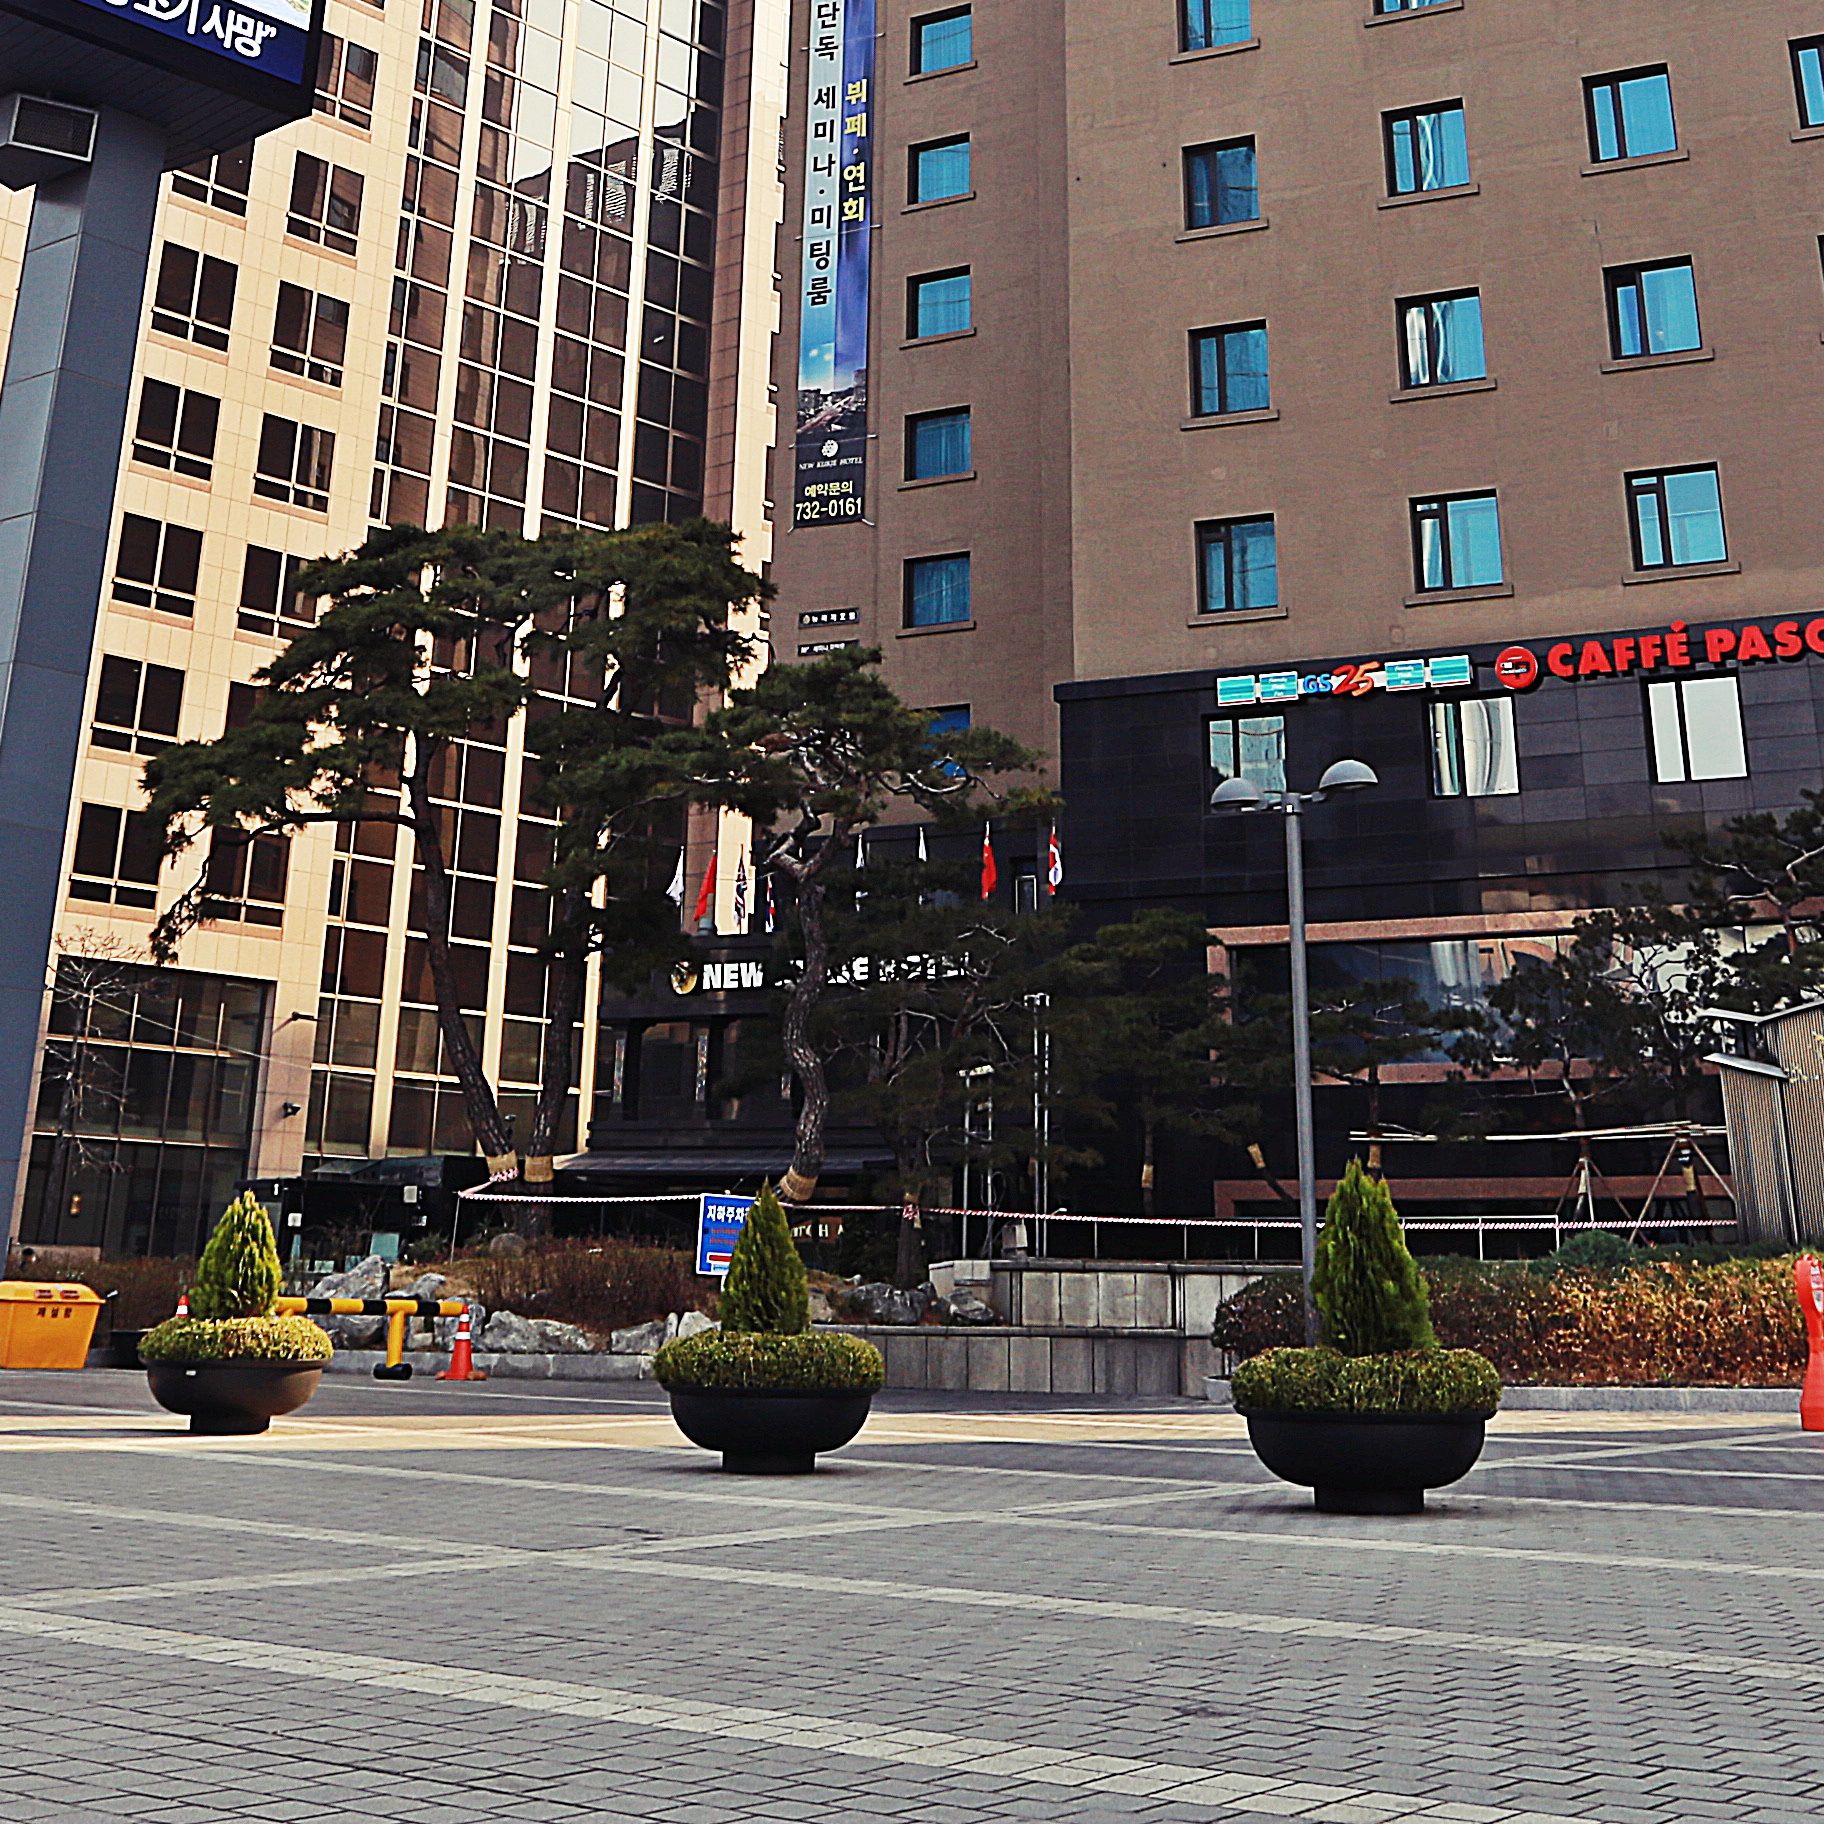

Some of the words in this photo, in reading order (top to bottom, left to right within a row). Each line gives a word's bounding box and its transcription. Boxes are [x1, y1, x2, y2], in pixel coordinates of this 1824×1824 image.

[814, 0, 840, 62] 단독
[804, 480, 854, 498] 예약문의
[795, 497, 862, 521] 732-0161
[1546, 619, 1691, 678] CAFFÉ
[1302, 660, 1382, 697] GS25
[702, 961, 764, 990] NEW
